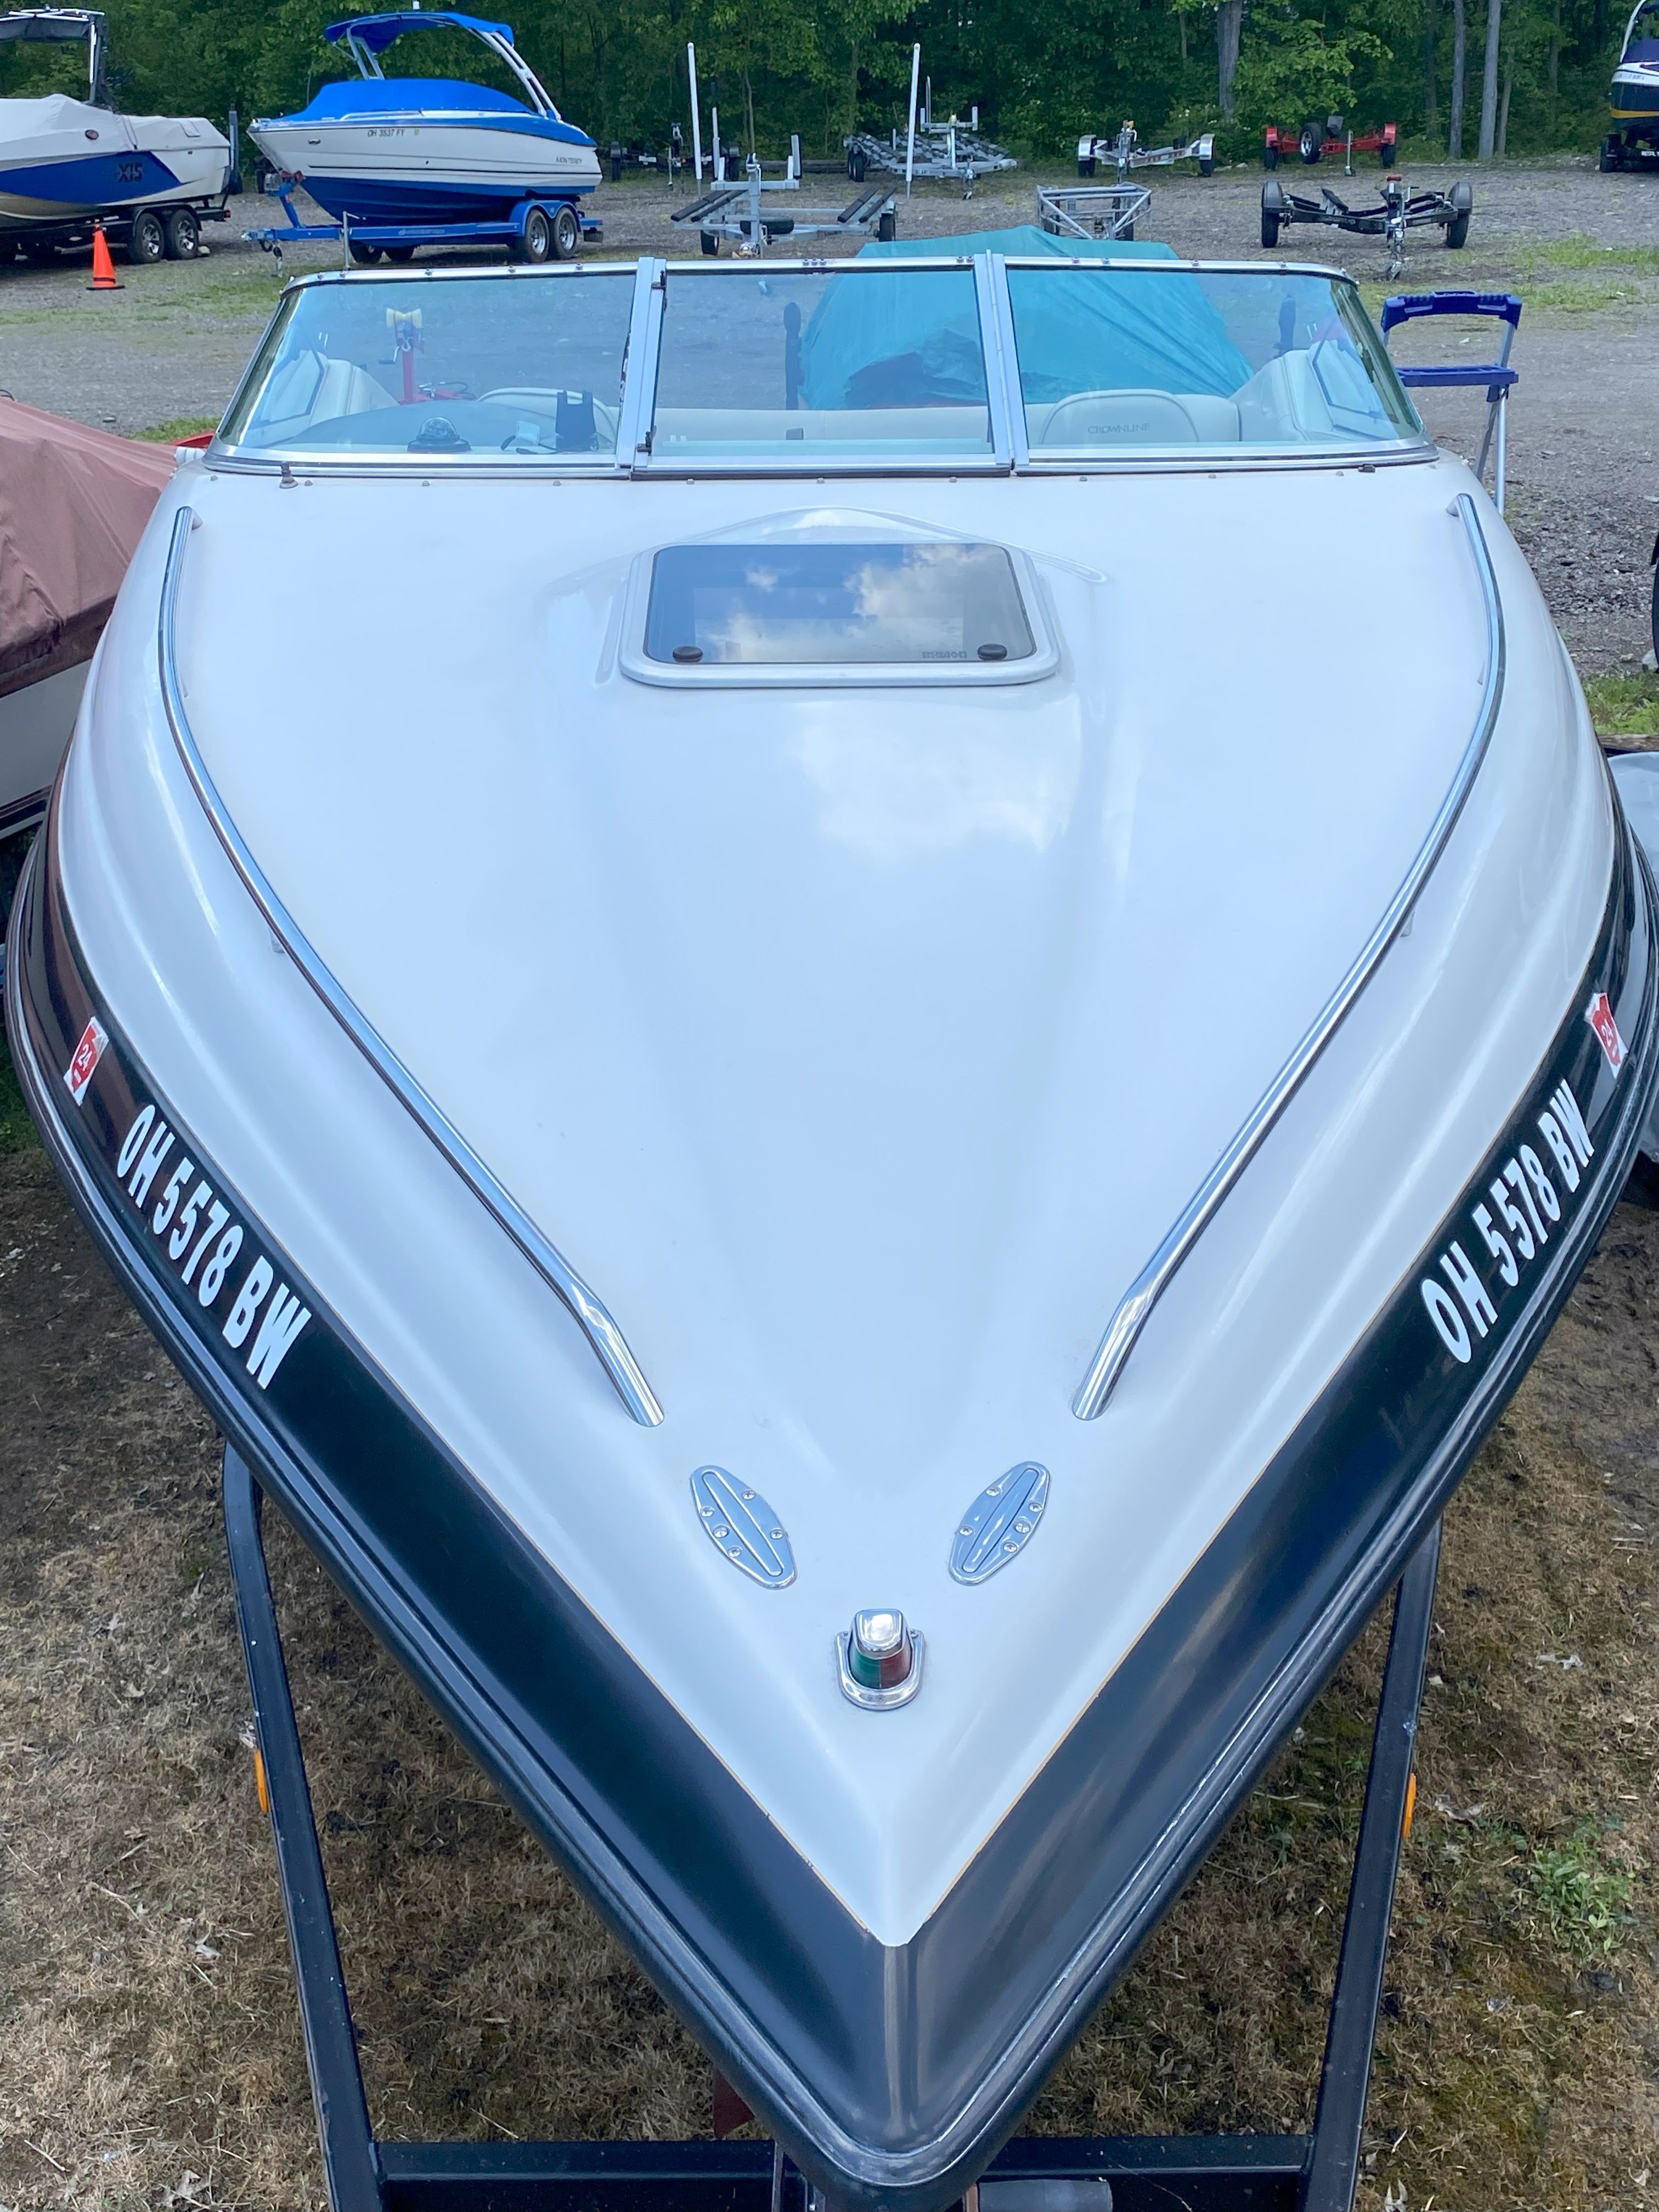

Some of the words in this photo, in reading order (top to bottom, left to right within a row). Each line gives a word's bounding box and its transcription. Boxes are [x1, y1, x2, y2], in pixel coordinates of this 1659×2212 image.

[1087, 423, 1150, 434] CROWNLINE
[77, 1043, 93, 1072] 24
[117, 1105, 175, 1208] OH
[153, 1158, 243, 1306] 5578
[223, 1256, 311, 1389] BW
[1422, 1241, 1498, 1363] OH
[1472, 1145, 1560, 1286] 5578
[1538, 1079, 1594, 1192] BW
